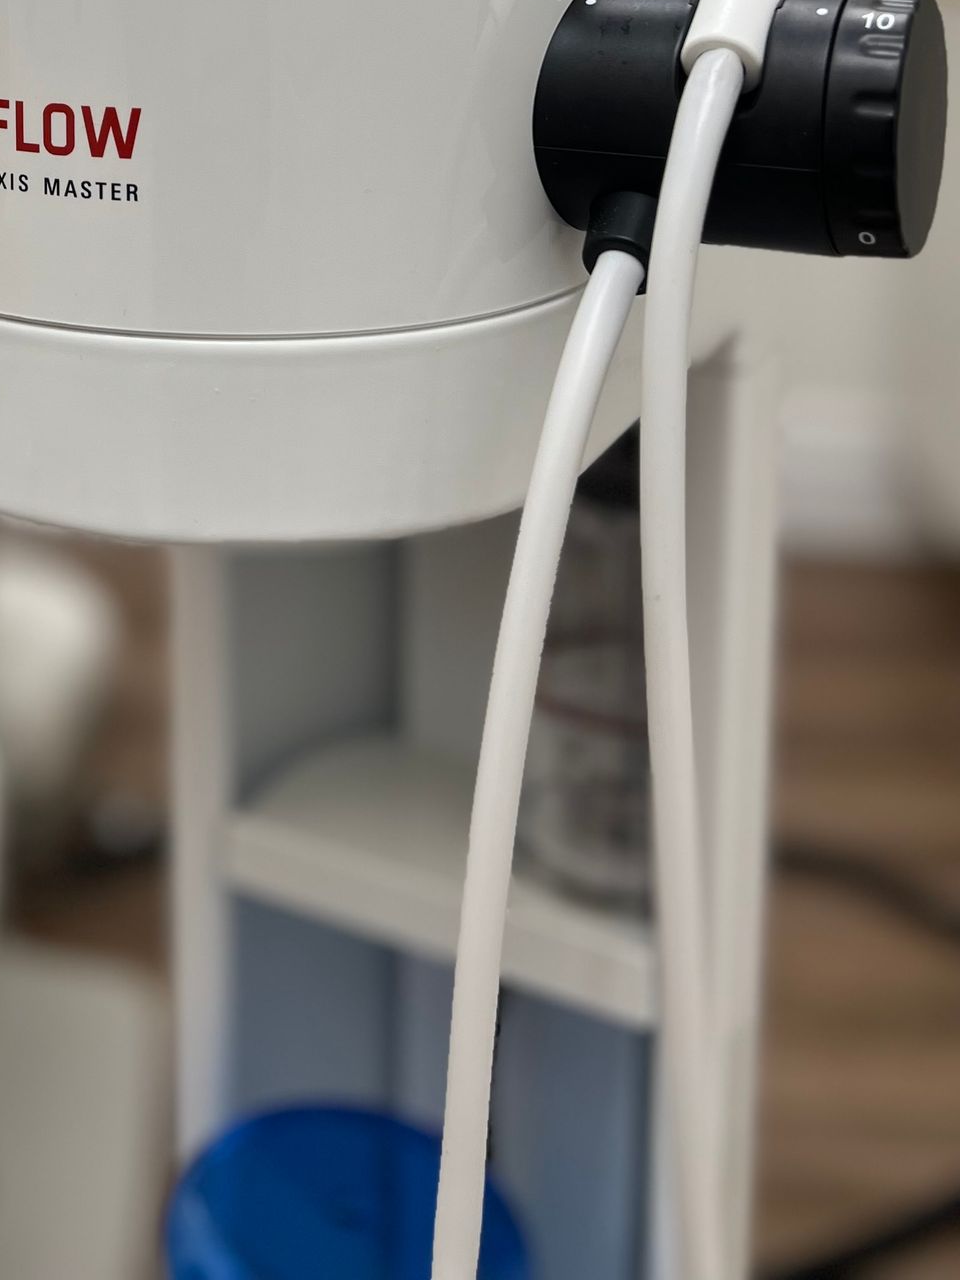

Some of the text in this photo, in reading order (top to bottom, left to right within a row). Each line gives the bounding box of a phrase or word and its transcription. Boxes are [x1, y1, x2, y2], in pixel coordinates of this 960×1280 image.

[861, 11, 895, 30] 10
[44, 177, 139, 202] MASTER
[858, 231, 876, 245] 0
